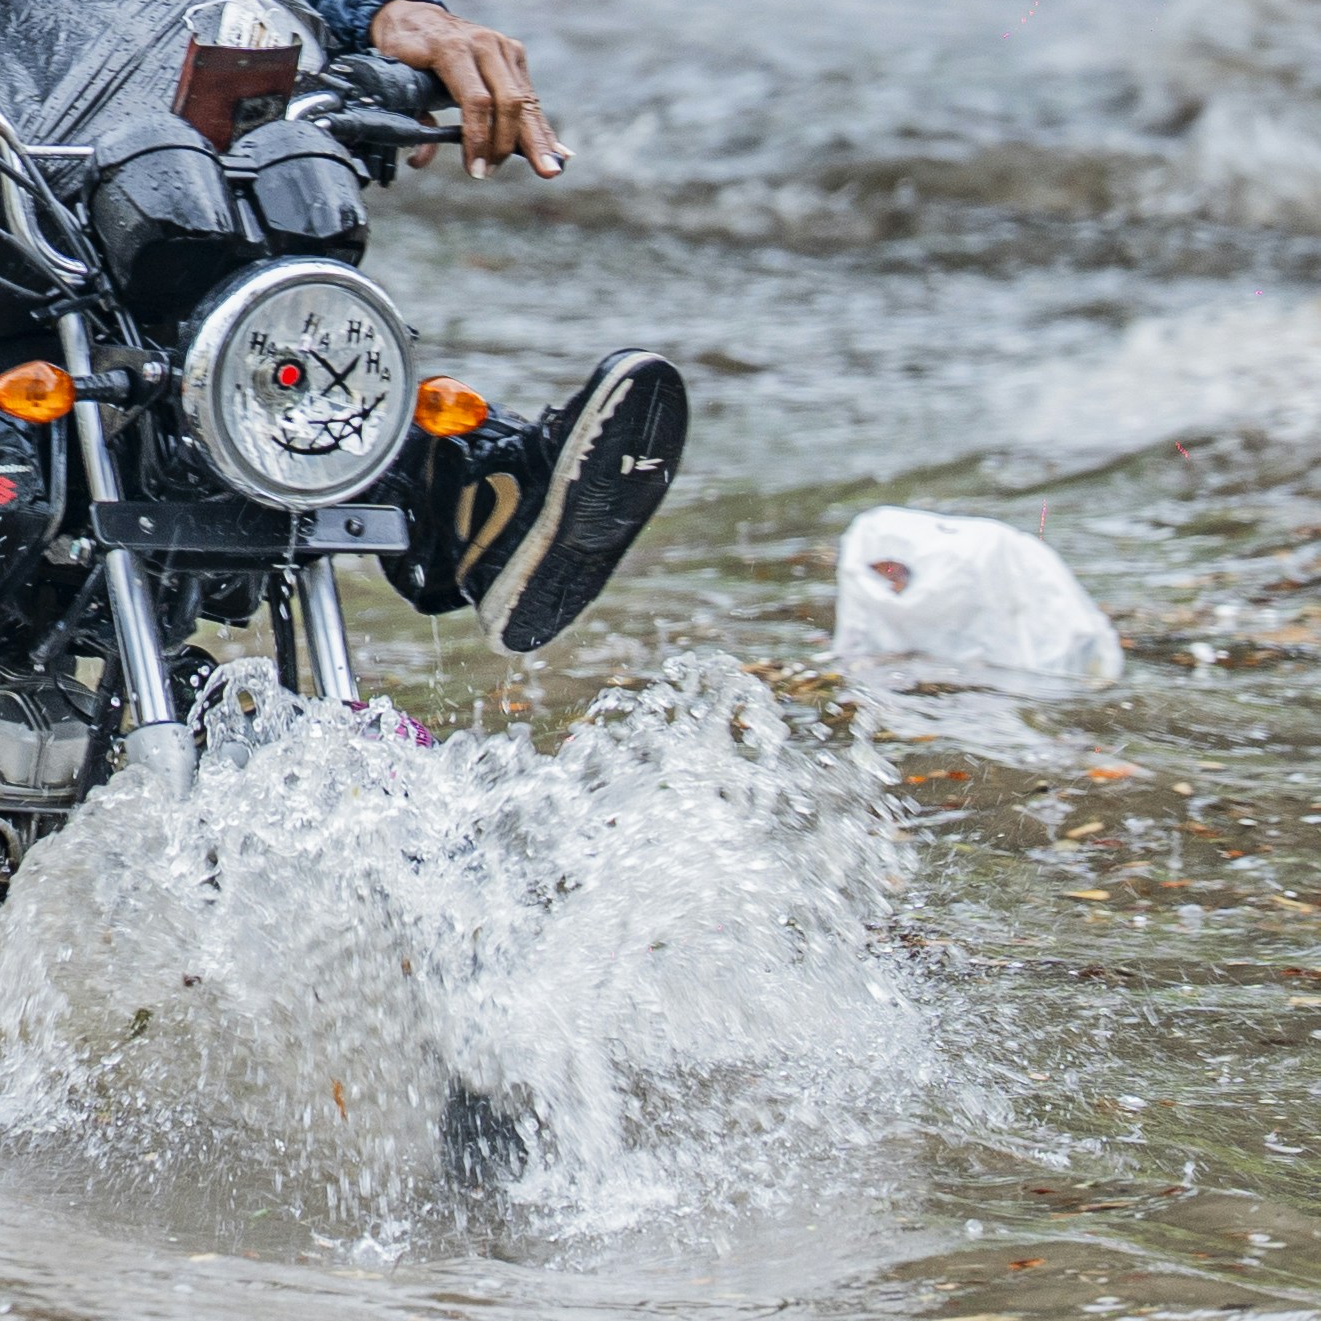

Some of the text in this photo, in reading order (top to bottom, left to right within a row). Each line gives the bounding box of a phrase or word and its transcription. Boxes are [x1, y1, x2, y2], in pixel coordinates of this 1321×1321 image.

[302, 312, 332, 350] HA
[346, 319, 375, 344] HA
[366, 350, 392, 382] HA
